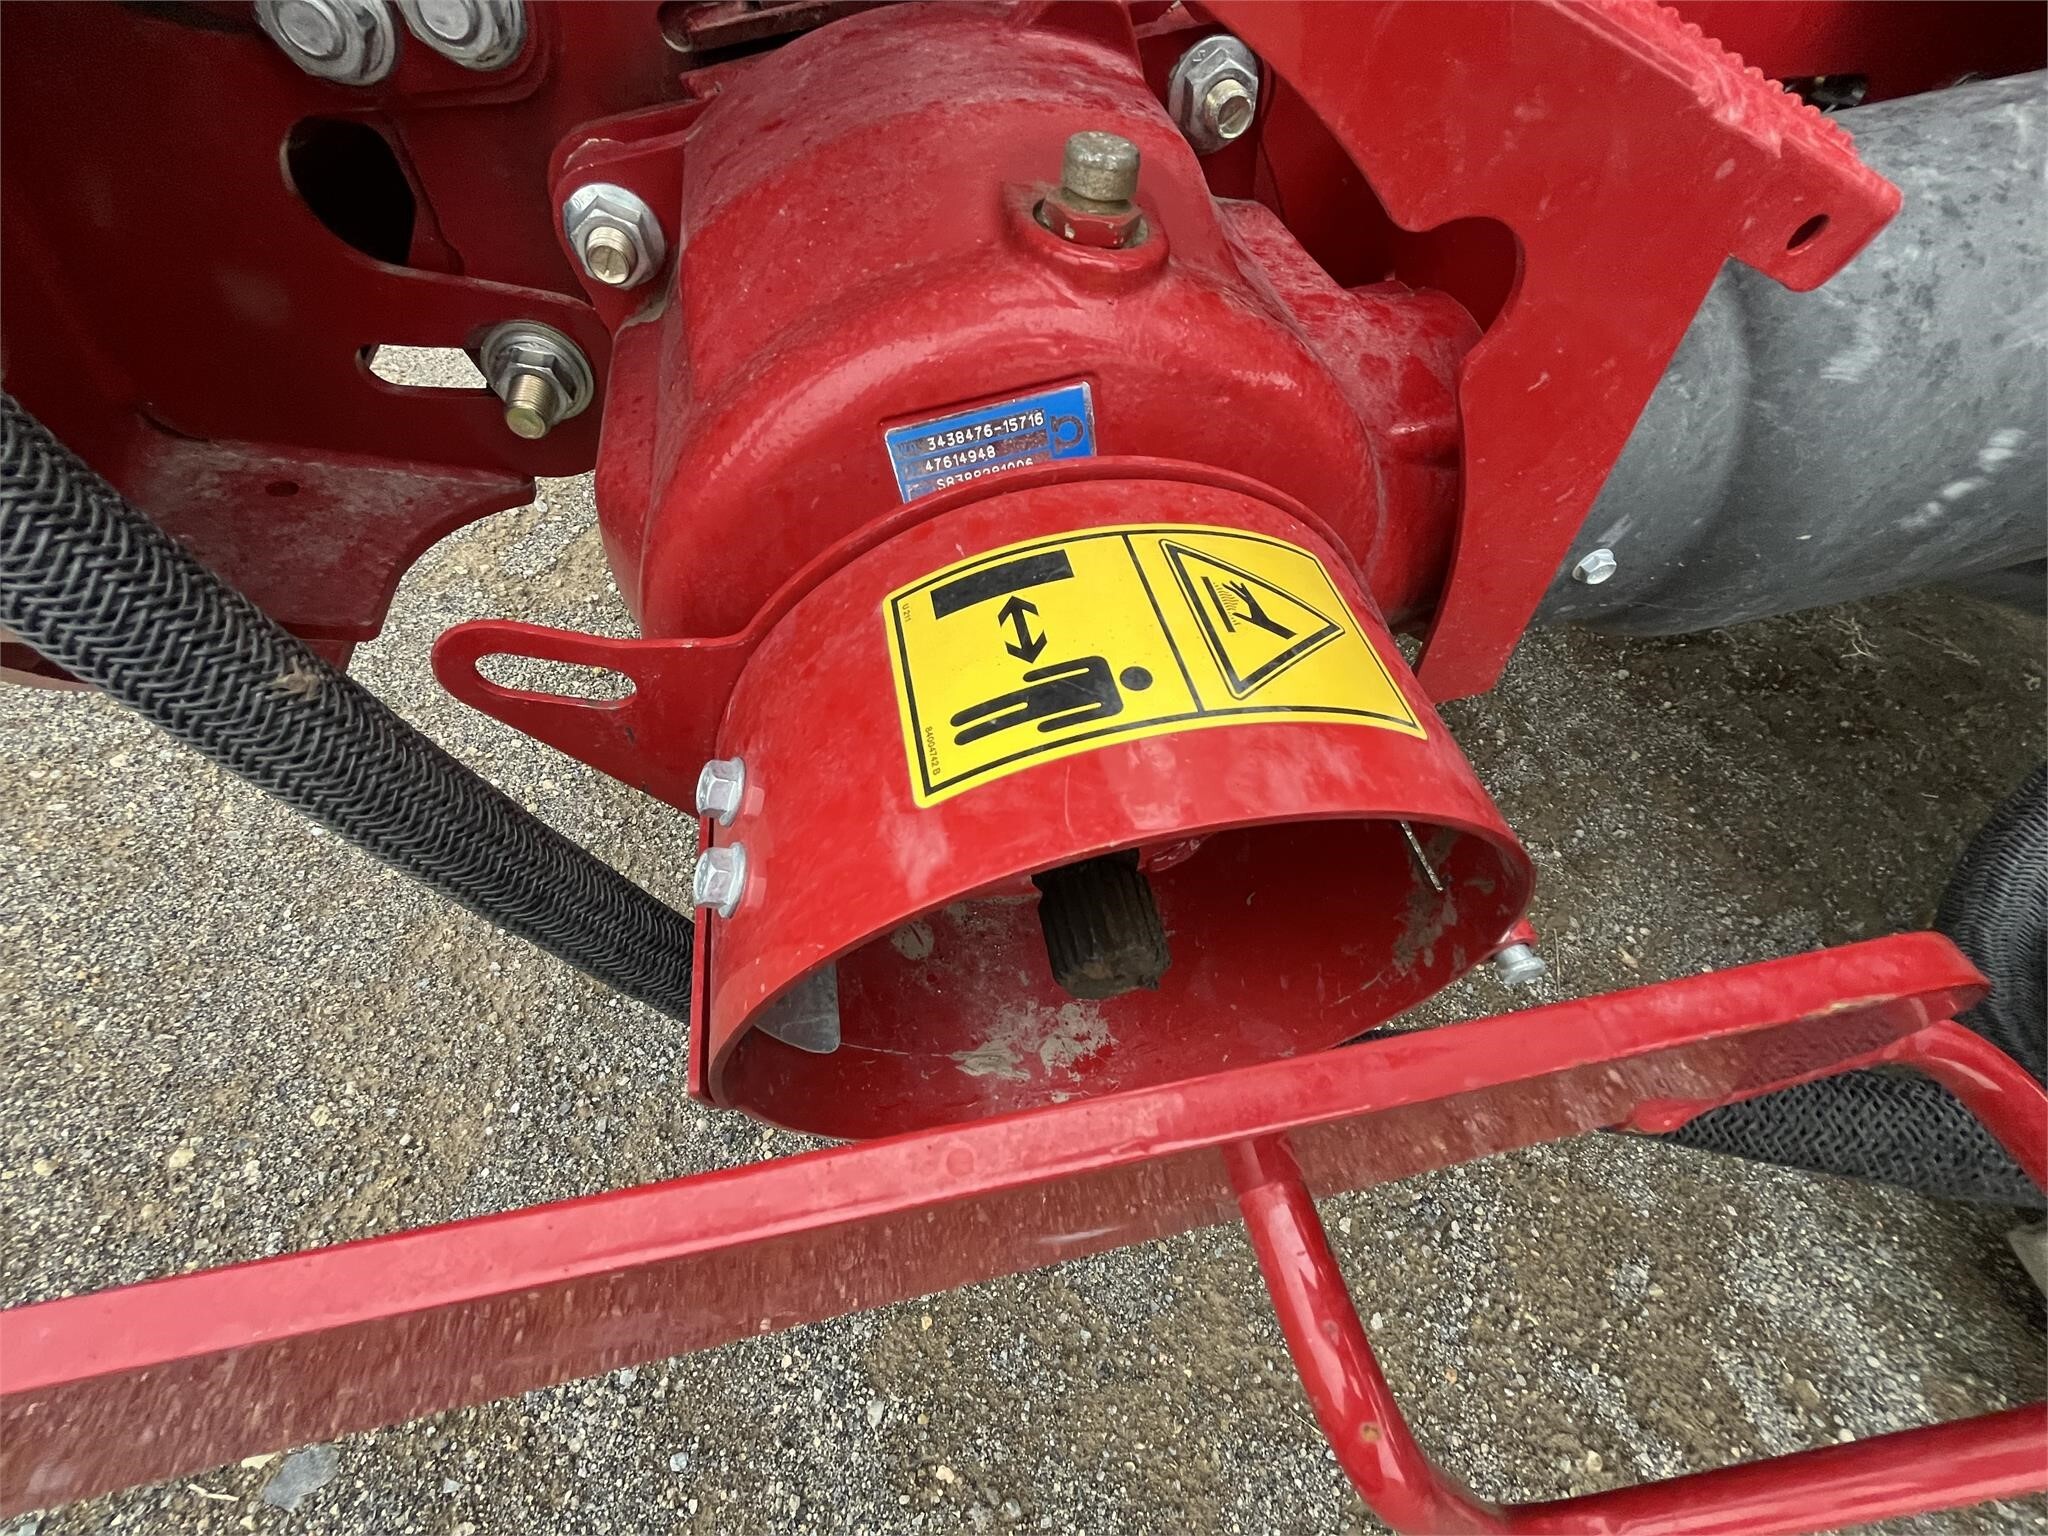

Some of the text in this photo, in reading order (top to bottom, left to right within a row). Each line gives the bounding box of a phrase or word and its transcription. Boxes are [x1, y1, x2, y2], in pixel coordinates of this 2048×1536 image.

[927, 411, 1044, 451] 3438476-15716
[925, 445, 996, 472] 47614948
[925, 726, 940, 768] 84004742
